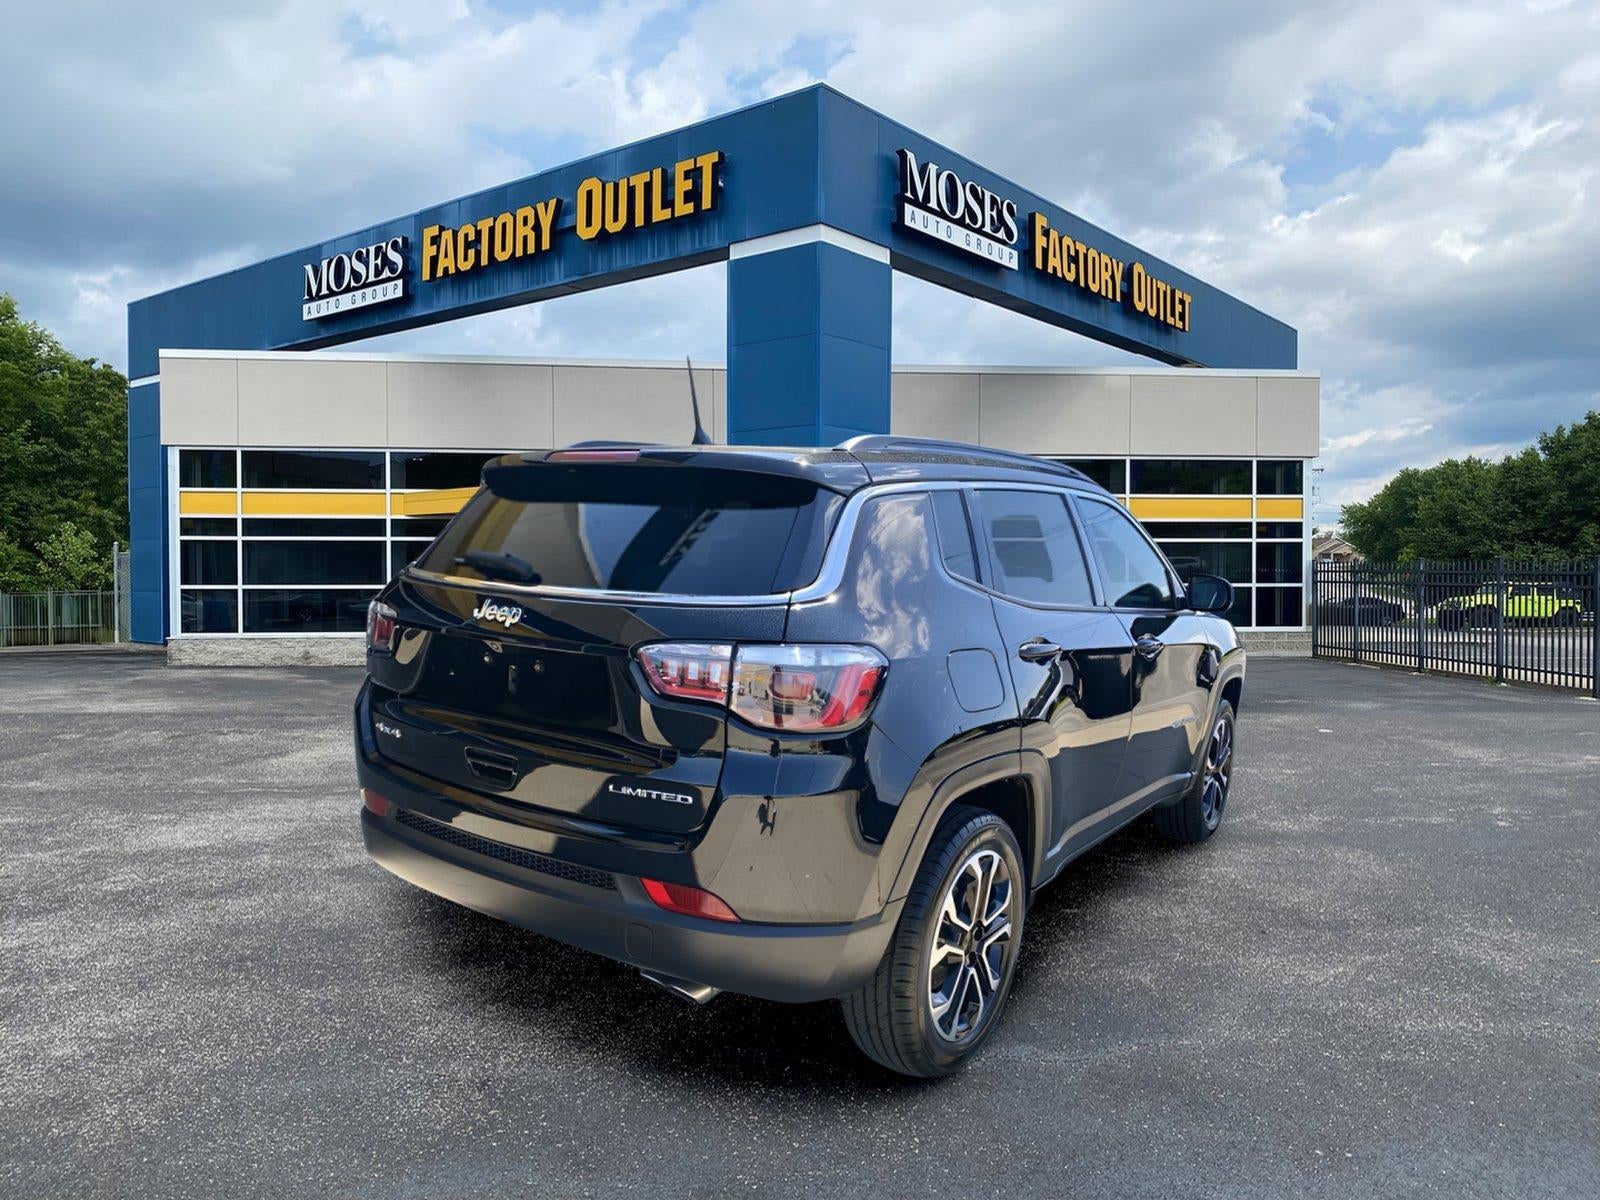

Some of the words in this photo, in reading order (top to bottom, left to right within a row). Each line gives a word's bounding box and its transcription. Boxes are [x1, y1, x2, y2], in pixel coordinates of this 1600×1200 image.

[422, 197, 560, 281] FACTORY
[576, 150, 720, 241] OUTLET
[903, 149, 1018, 245] MOSES
[909, 210, 953, 239] AUTO
[965, 226, 1015, 263] GROUP
[303, 236, 404, 300] MOSES
[1034, 211, 1124, 303] FACTORY
[1132, 261, 1192, 332] OUTLET
[307, 296, 340, 316] AUTO
[350, 283, 399, 305] GROUP
[472, 598, 523, 629] Jeep
[608, 783, 694, 805] LIMITED
